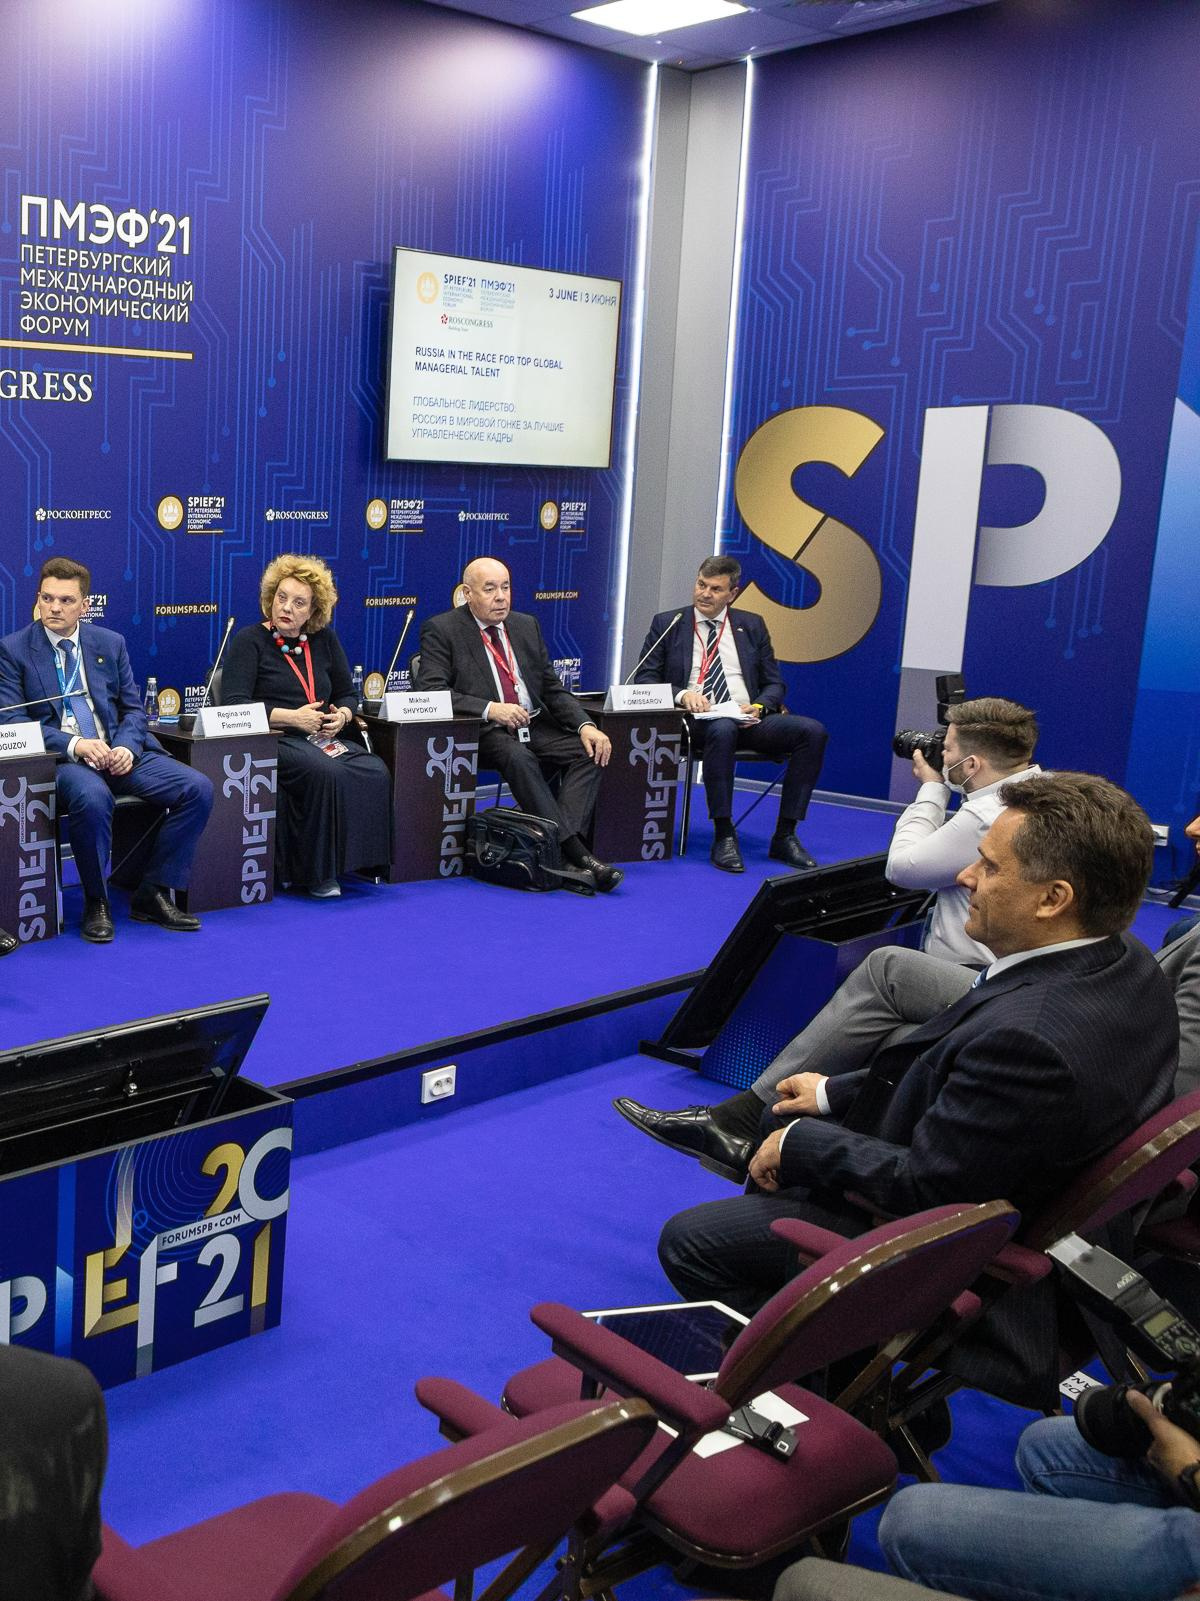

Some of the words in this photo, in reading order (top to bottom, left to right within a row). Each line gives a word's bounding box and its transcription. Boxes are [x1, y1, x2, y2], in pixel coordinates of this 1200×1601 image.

[20, 194, 192, 256] ПМЭФ'21
[20, 243, 171, 278] ПЕТЕРБУРГСКИЙ
[20, 267, 194, 303] МЕЖДУНАРОДНЫЙ
[444, 273, 476, 288] SPIEF'21
[481, 279, 516, 293] ПМЭФ'21
[549, 288, 554, 298] 3
[556, 289, 578, 302] JUNE
[585, 293, 589, 303] 3
[591, 294, 617, 306] ИЮНЯ
[19, 291, 191, 324] ЭКОНОМИЧЕСКИЙ
[19, 314, 90, 338] ФОРУМ
[448, 316, 494, 328] ROSCONGRESS
[415, 346, 445, 358] RUSSIA
[448, 350, 456, 359] IN
[458, 351, 473, 361] THE
[475, 352, 497, 363] RACE
[499, 355, 515, 365] FOR
[517, 356, 532, 366] TOP
[533, 358, 563, 370] GLOBAL
[415, 362, 468, 375] MANAGERIAL
[471, 367, 500, 378] TALENT
[413, 396, 466, 410] ГЛОБАЛЬНОЕ
[412, 414, 447, 425] РОССИЯ
[449, 416, 455, 426] В
[456, 416, 495, 428] МИРОВОЙ
[497, 419, 521, 430] ГОНКЕ
[522, 420, 533, 430] ЗА
[534, 421, 565, 433] ЛУЧШИЕ
[412, 428, 485, 442] УПРАВЛЕНЧЕСКИЕ
[487, 432, 513, 443] КАДРЫ
[188, 496, 225, 507] SPIEF'21
[391, 500, 424, 509] ПМЭФ'21
[561, 502, 587, 511] SPIEF'21
[47, 509, 112, 521] РОСКОНГРЕСС
[275, 511, 328, 520] ROSCONGRESS
[466, 512, 509, 521] РОСКОНГРЕСС
[365, 597, 416, 606] FORUMSPB.COM
[535, 591, 578, 599] FORUMSPB.COM
[156, 604, 217, 615] FORUMSPB.COM
[217, 711, 238, 719] Regina
[222, 721, 251, 729] Flemming
